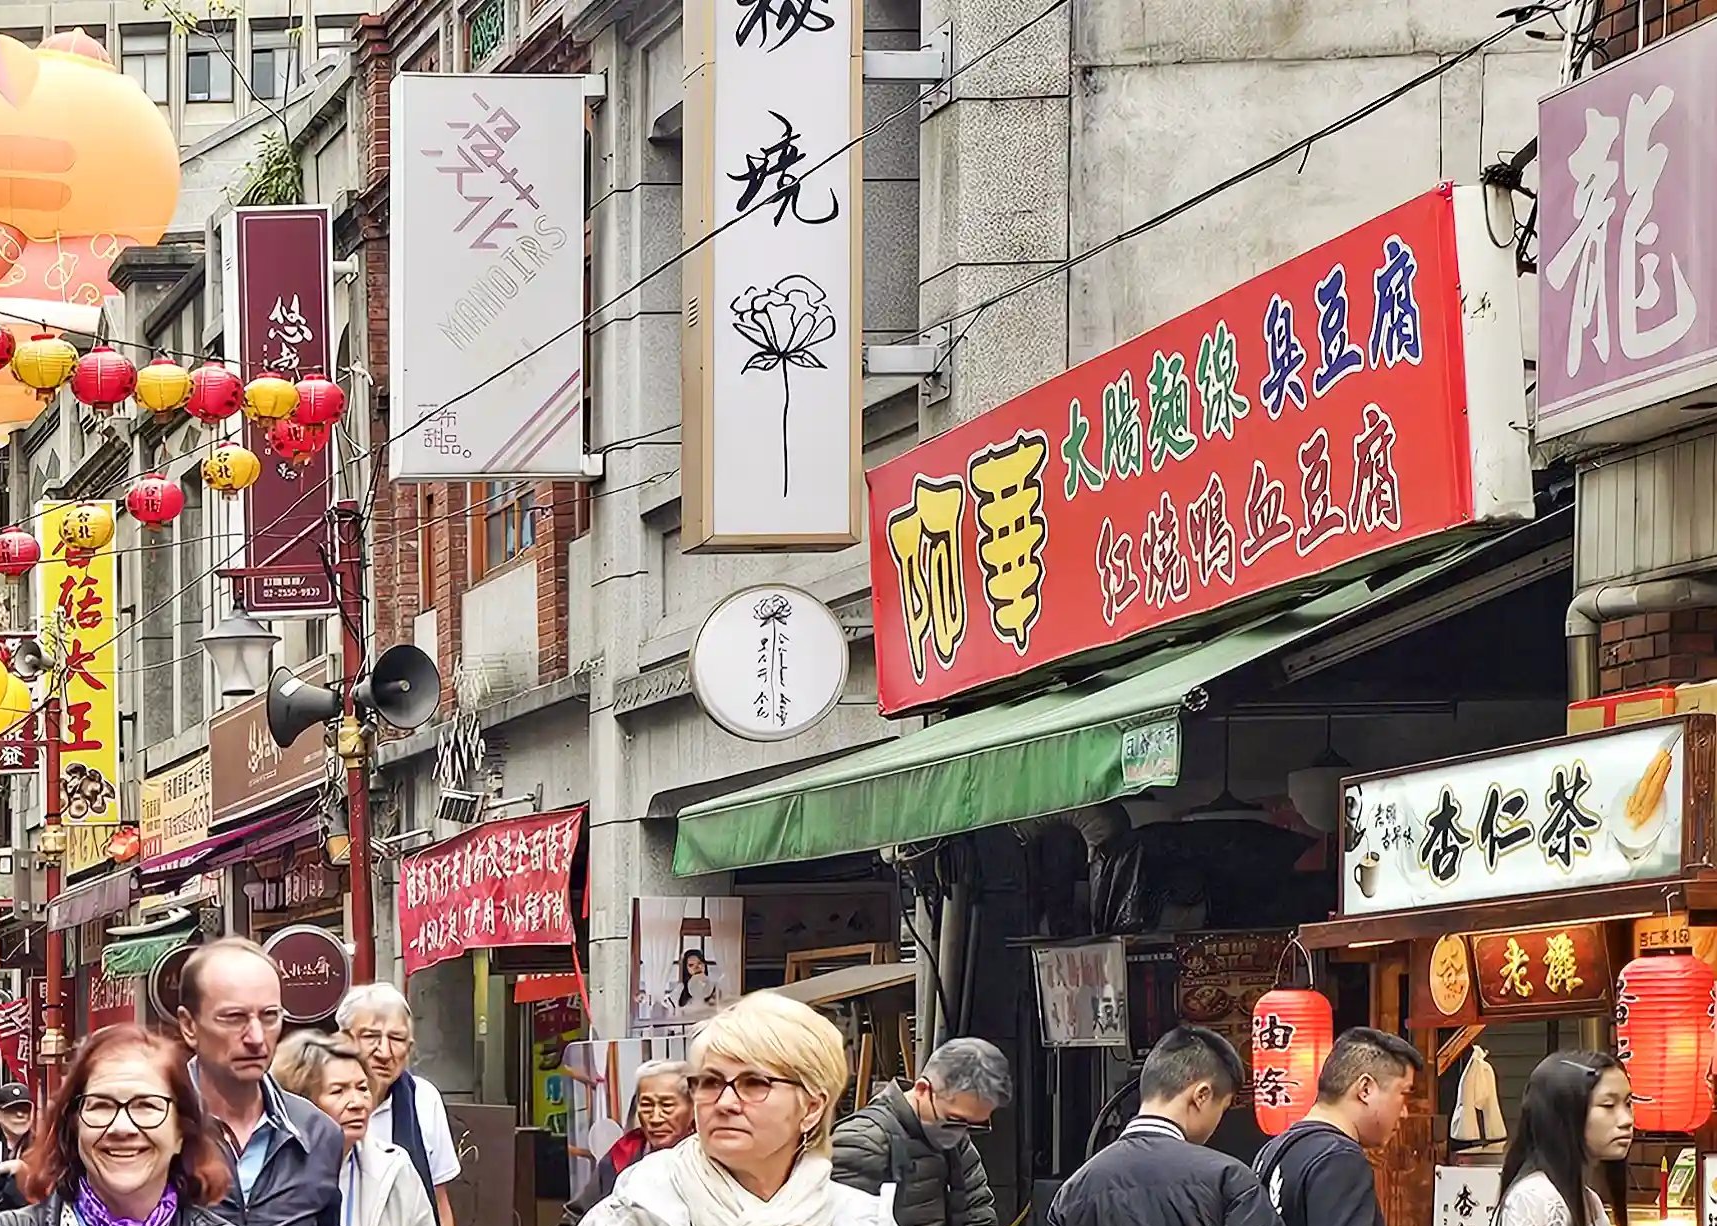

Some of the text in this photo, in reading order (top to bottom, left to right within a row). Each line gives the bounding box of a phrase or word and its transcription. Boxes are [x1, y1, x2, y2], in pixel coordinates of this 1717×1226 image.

[1545, 84, 1697, 378] 龍
[1061, 234, 1424, 500] 大腸麵線 臭豆腐
[888, 428, 1049, 685] 阿華
[1096, 402, 1402, 626] 紅燒鴨血豆腐
[1419, 761, 1600, 885] 杏仁茶
